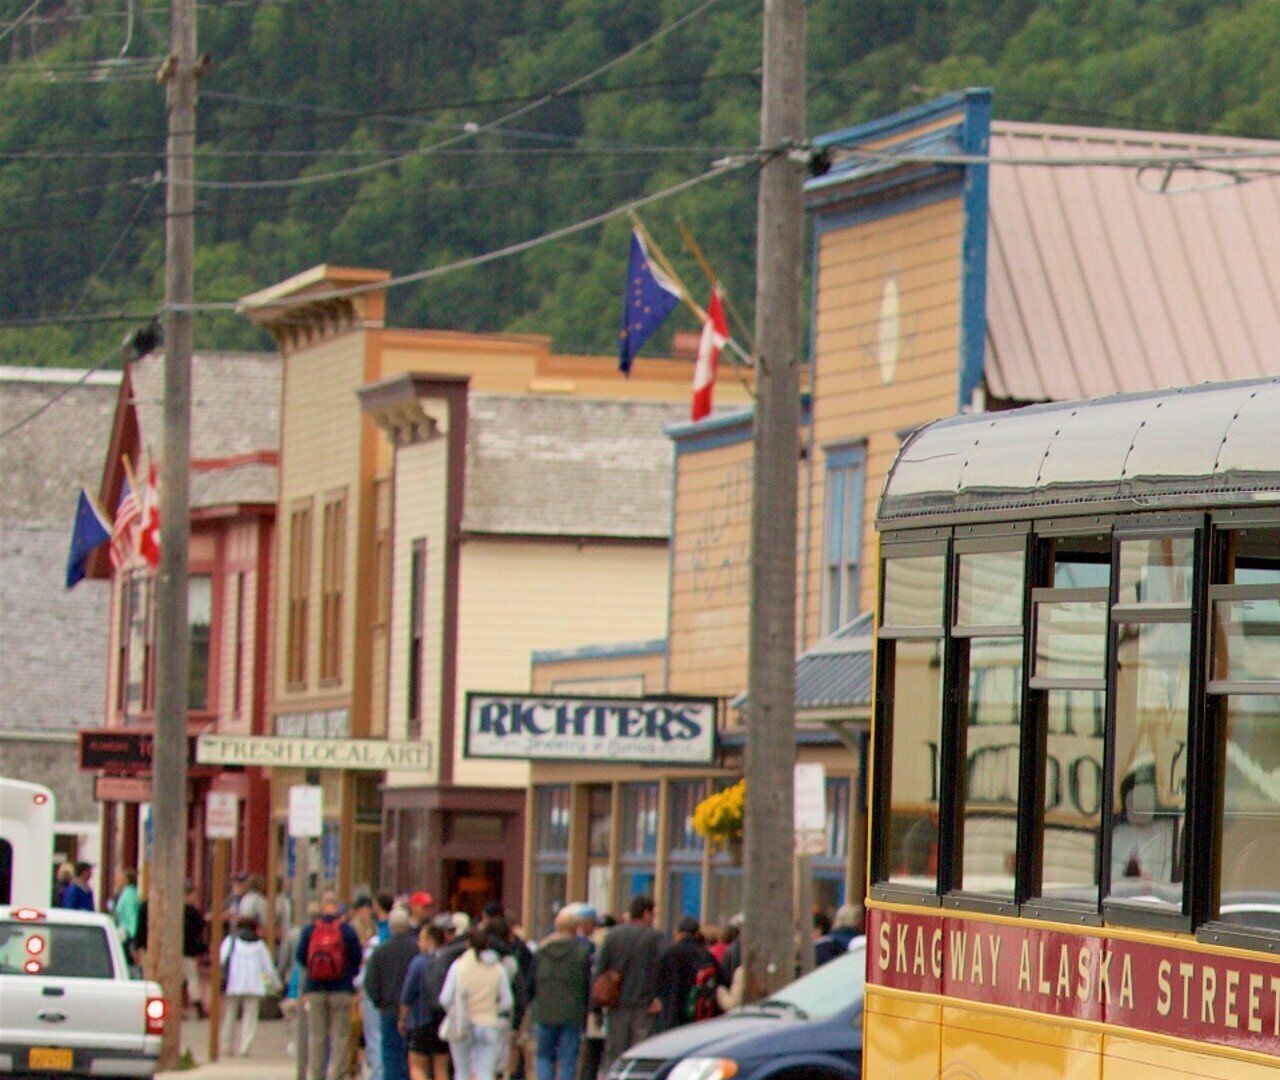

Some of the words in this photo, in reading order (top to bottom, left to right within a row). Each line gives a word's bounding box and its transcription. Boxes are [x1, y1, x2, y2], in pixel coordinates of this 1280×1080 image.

[479, 700, 703, 741] RICHTERS
[219, 740, 293, 759] FRESH
[299, 743, 376, 762] LOCAL
[381, 746, 423, 765] ART
[878, 921, 1001, 988] SKAGWAY
[1018, 938, 1135, 1010] ALASKA
